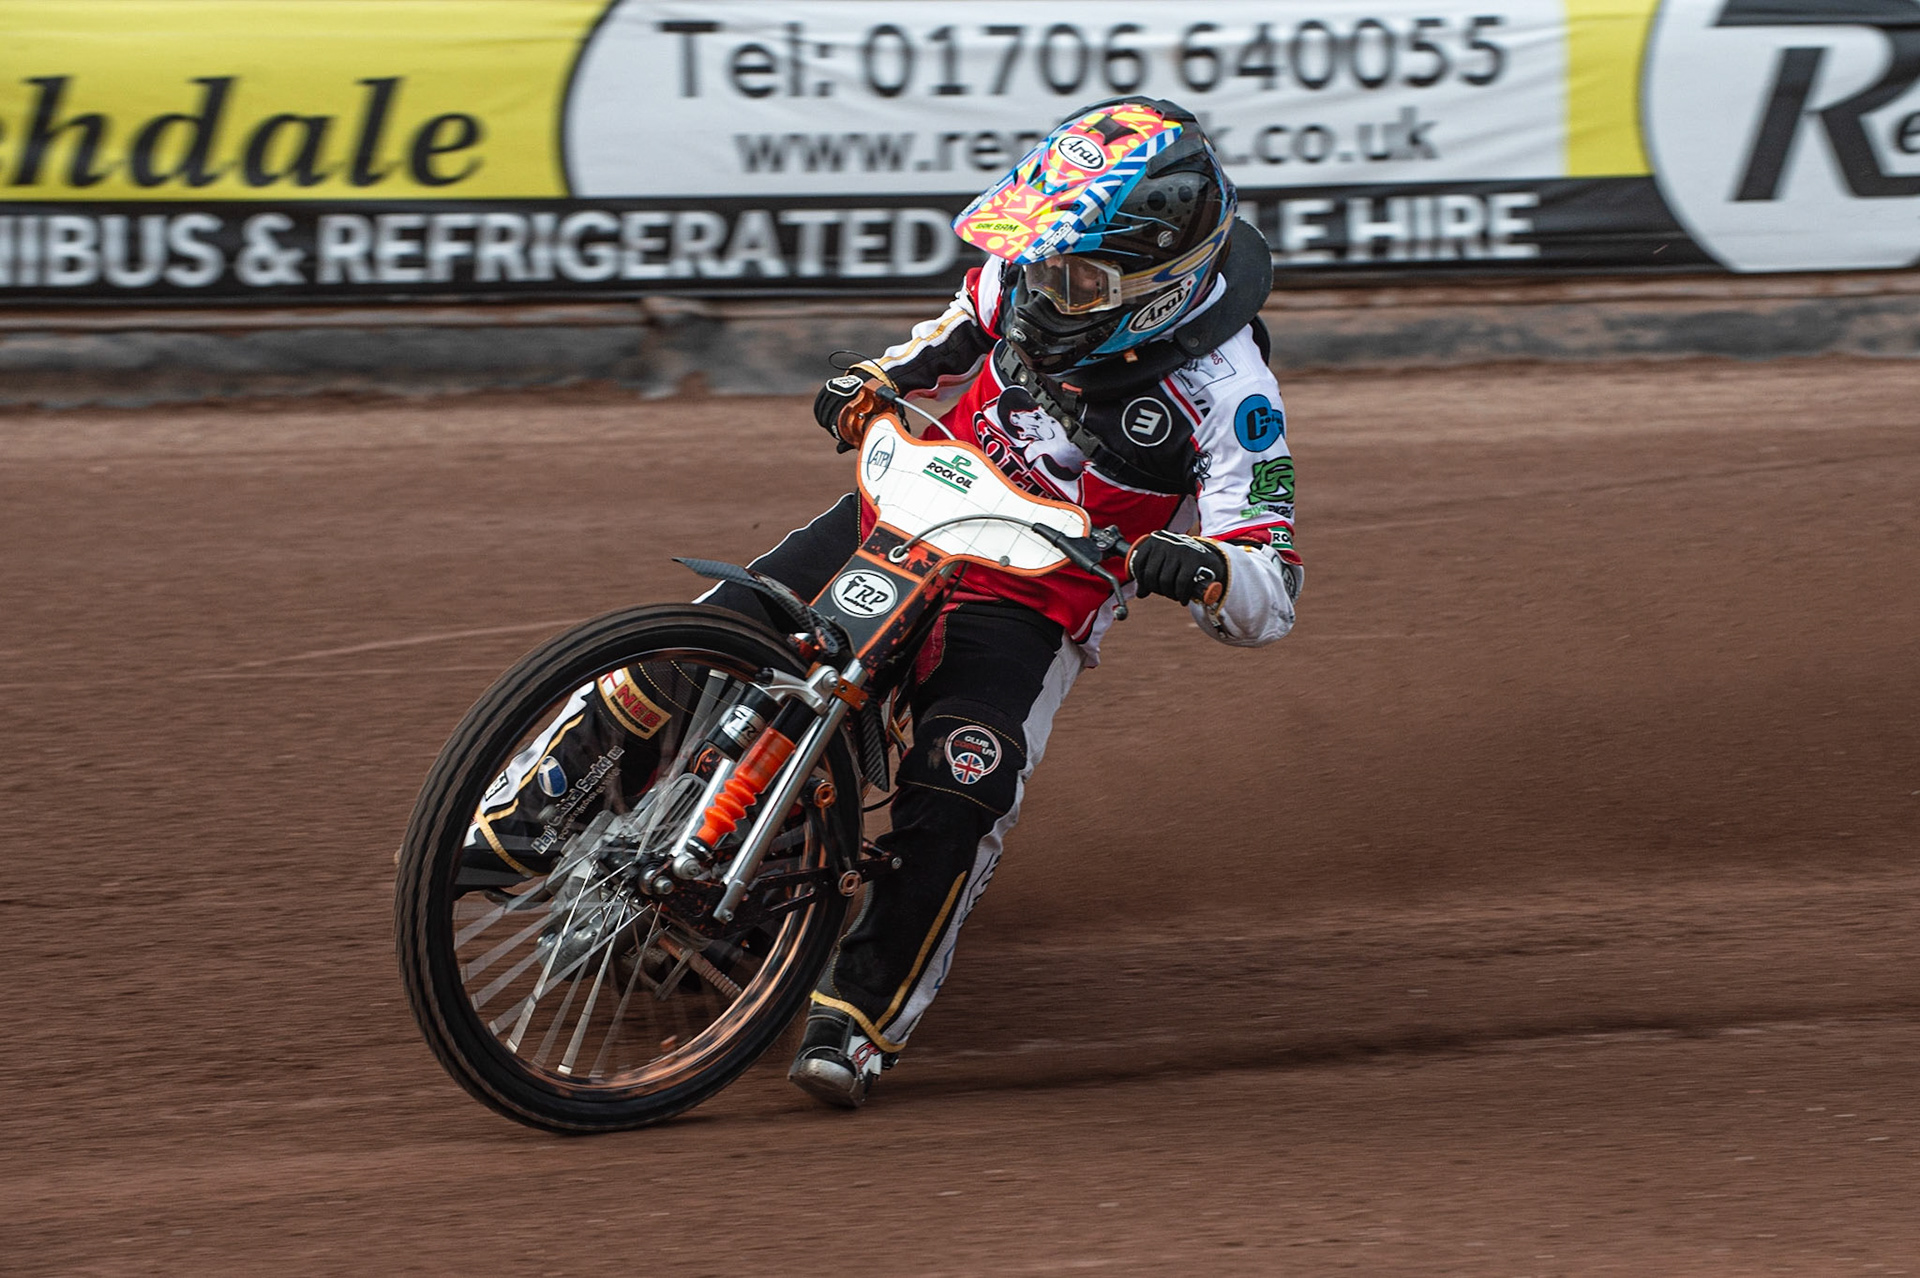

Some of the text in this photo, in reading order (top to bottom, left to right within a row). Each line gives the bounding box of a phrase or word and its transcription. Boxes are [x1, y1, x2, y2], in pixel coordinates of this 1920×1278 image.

[660, 15, 1506, 98] Tel: 01706 640055
[0, 75, 488, 189] hdale
[1059, 137, 1101, 165] Arai
[236, 213, 305, 286] &
[316, 207, 957, 283] REFRIGERATED
[1349, 192, 1540, 261] HIRE
[1140, 287, 1190, 328] Arai
[926, 461, 974, 489] ROCK OIL
[964, 735, 989, 748] CLUB
[981, 748, 996, 758] UK
